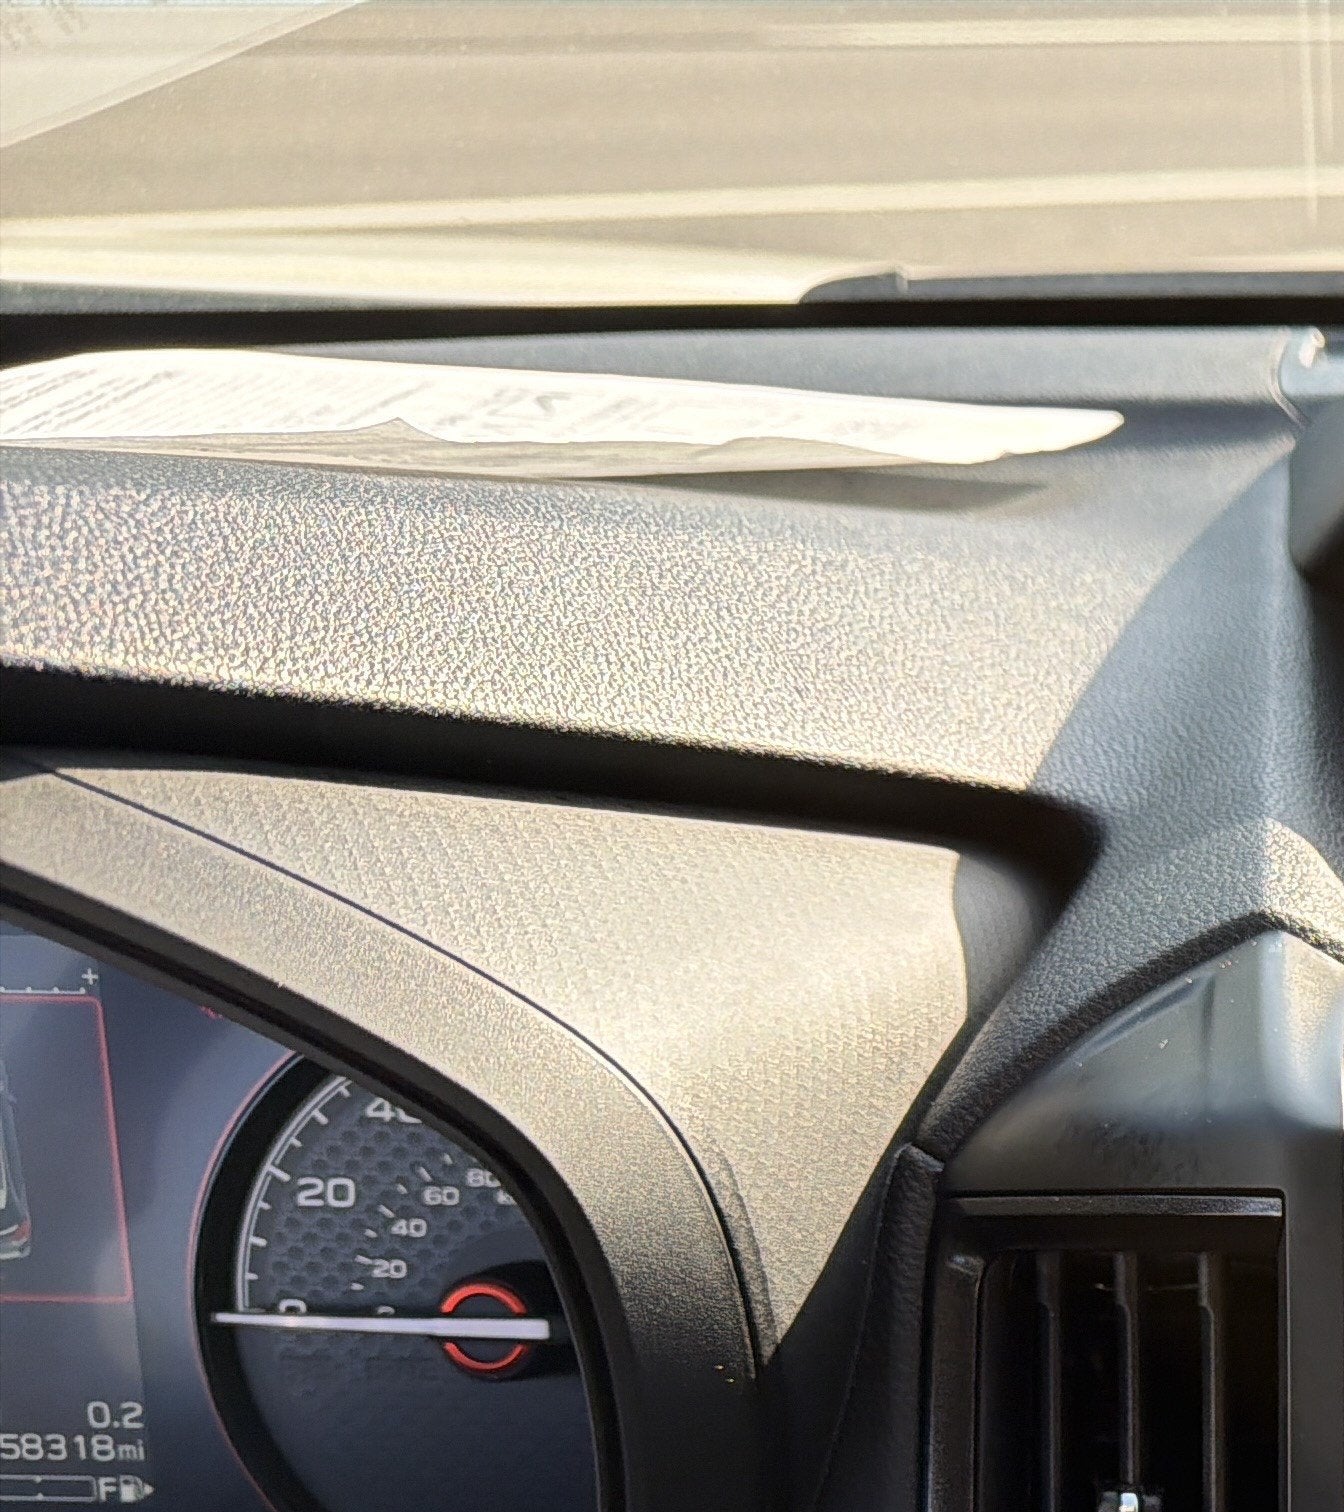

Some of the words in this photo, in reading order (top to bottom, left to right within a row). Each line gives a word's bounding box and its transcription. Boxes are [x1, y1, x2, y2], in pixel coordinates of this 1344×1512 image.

[296, 1177, 355, 1208] 20
[423, 1186, 460, 1206] 60
[391, 1218, 427, 1238] 40
[372, 1259, 407, 1279] 20
[87, 1401, 145, 1429] 0.2
[98, 1477, 117, 1501] F
